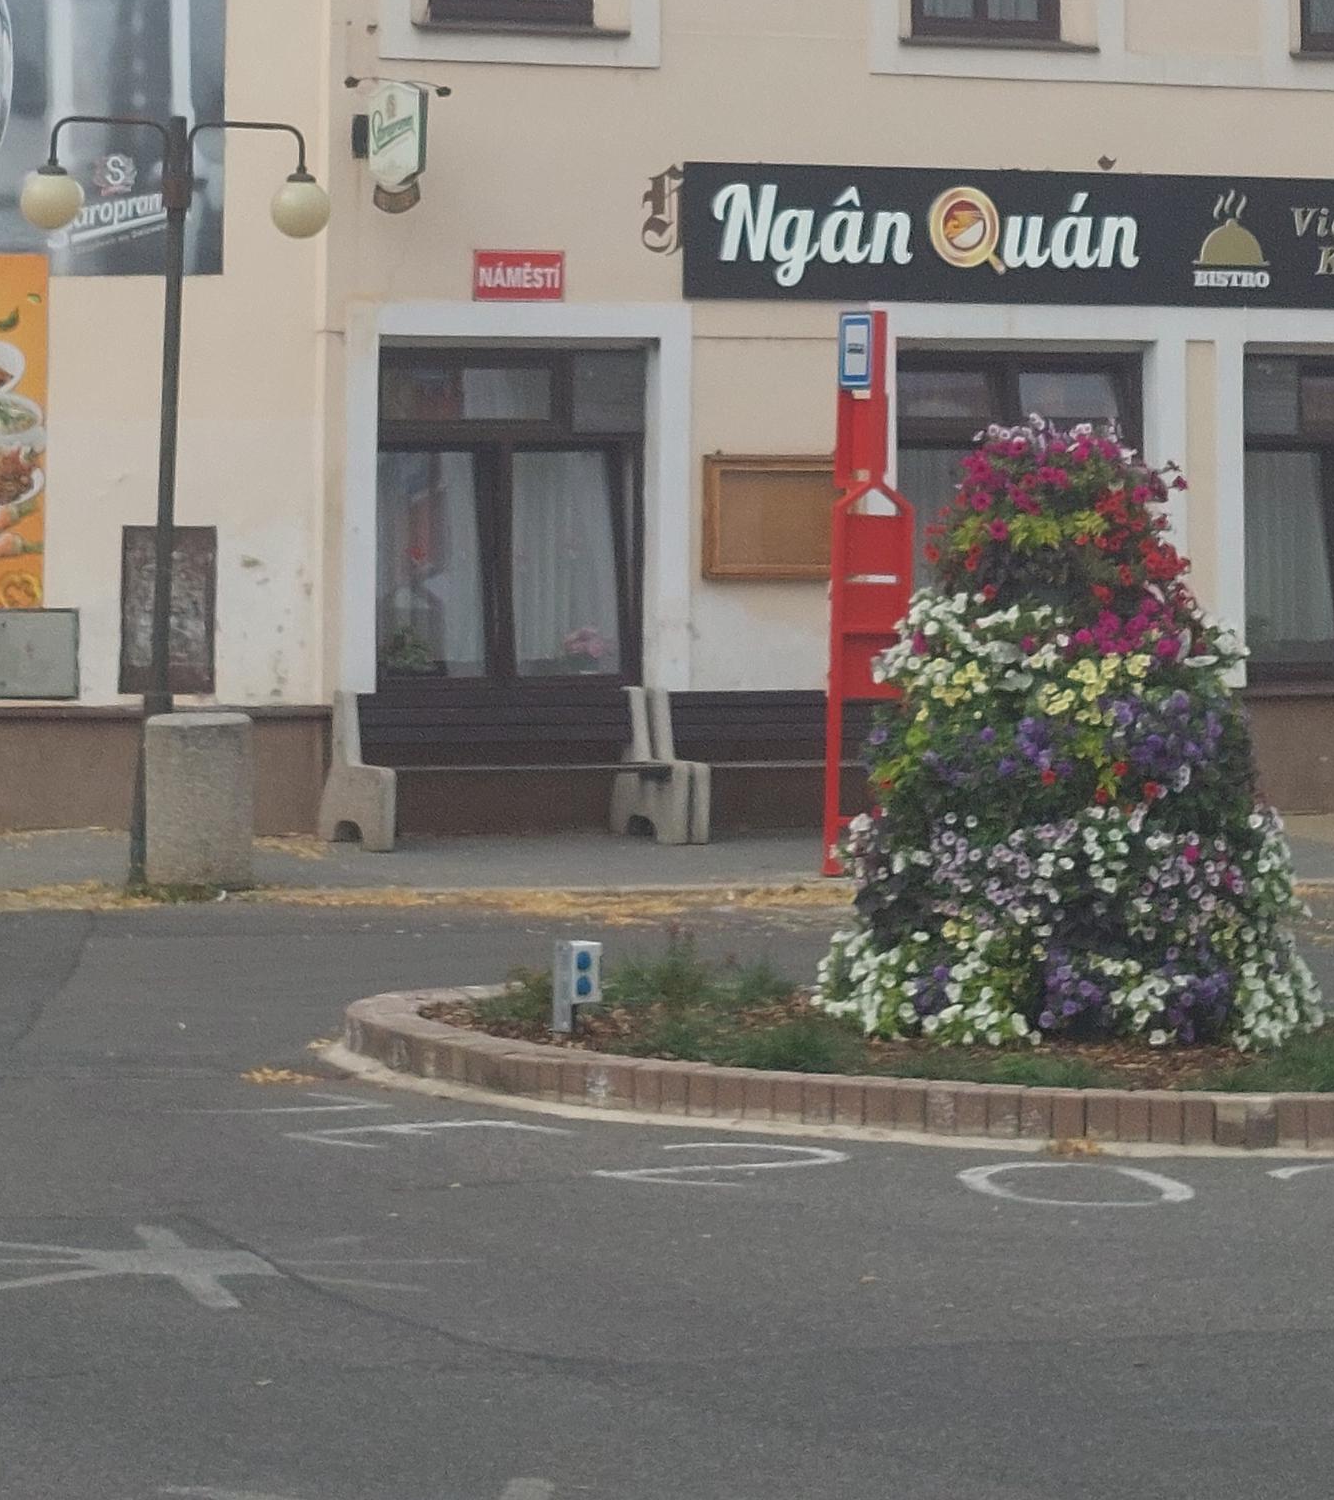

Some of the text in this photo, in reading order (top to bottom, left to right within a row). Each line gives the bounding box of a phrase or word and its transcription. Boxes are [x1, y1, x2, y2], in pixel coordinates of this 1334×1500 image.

[712, 183, 914, 288] Ngân
[928, 186, 1140, 276] Quán
[478, 262, 561, 290] NÁMĚSTÍ
[1192, 270, 1271, 289] BISTRO
